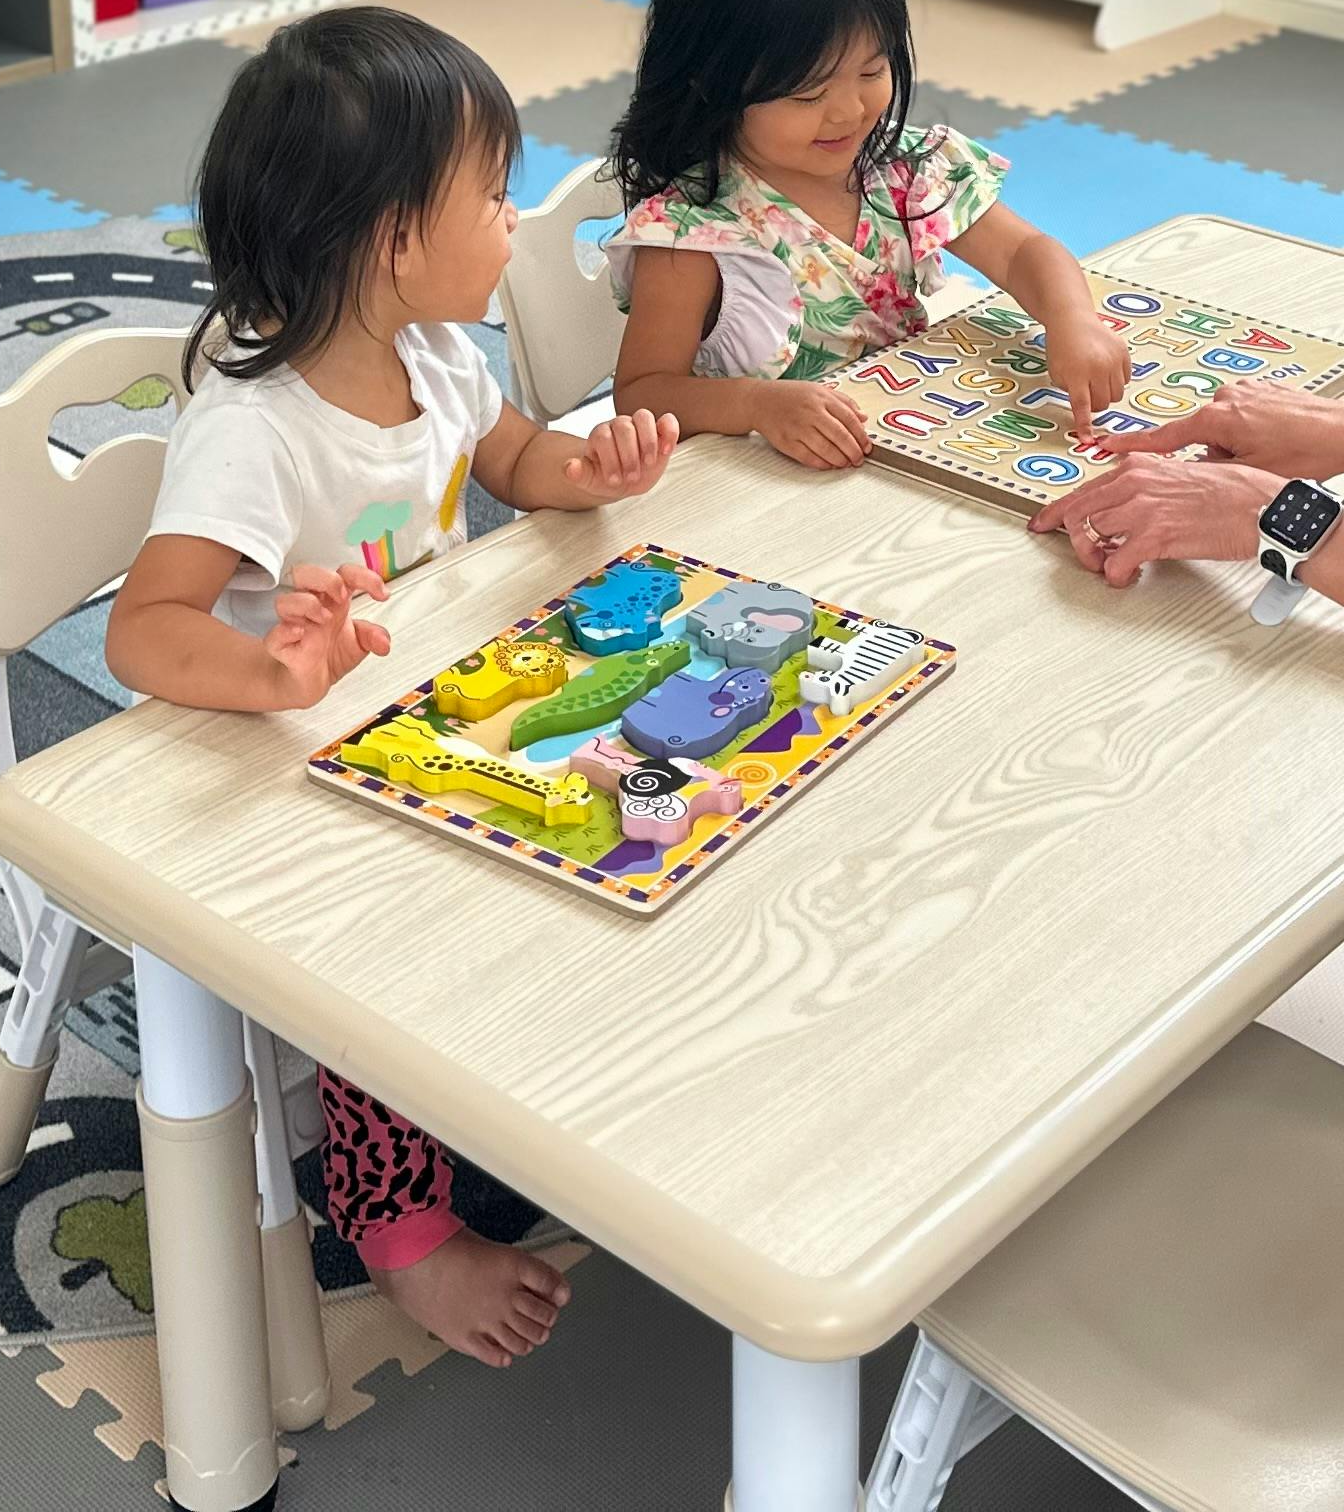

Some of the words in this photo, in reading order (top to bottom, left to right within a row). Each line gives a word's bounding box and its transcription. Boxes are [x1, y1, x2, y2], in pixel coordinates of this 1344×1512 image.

[1106, 292, 1162, 314] O
[1163, 309, 1231, 335] H
[927, 327, 994, 355] X
[1133, 328, 1200, 355] I
[1232, 328, 1293, 351] A
[899, 350, 958, 374] Y
[989, 349, 1048, 375] R
[1202, 348, 1266, 372] B
[855, 364, 921, 391] Z
[957, 369, 1016, 395] S
[1166, 370, 1225, 394] C
[924, 392, 986, 417] T
[1134, 389, 1197, 414] D
[882, 409, 948, 437] U
[982, 409, 1056, 440] M
[943, 429, 1017, 461] N
[1017, 454, 1080, 482] G
